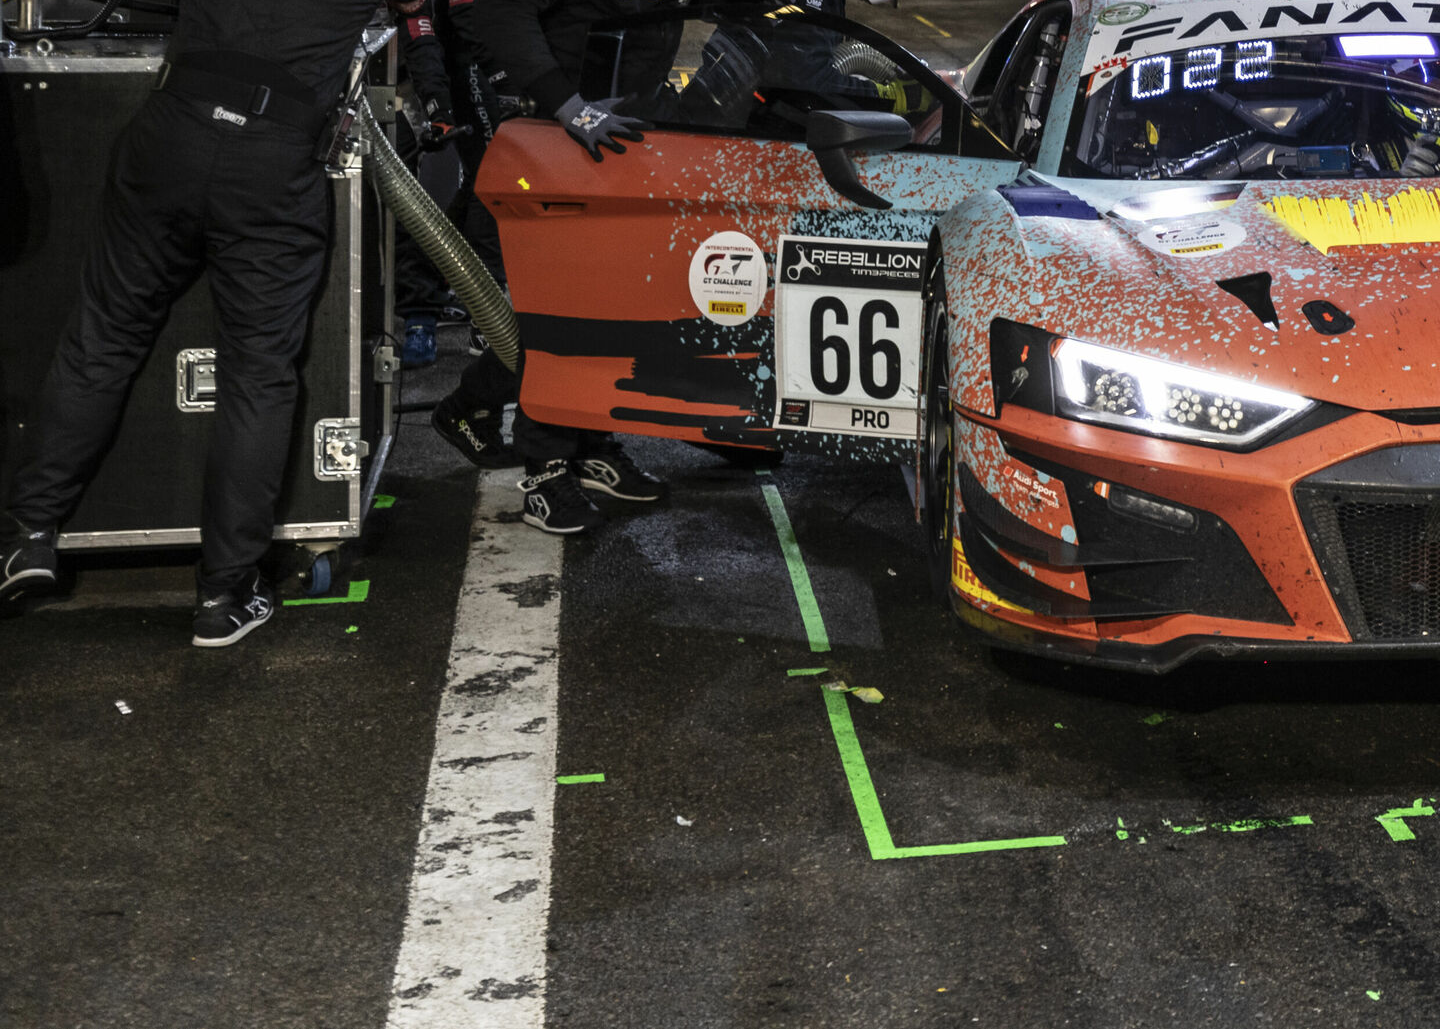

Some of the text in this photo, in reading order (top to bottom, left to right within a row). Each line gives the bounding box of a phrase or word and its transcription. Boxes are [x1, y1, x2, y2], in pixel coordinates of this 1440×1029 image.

[1131, 39, 1273, 99] 022
[704, 245, 754, 253] INTERCONTINENTAL
[811, 249, 921, 270] REBELLION
[713, 278, 753, 287] CHALLENGE
[711, 303, 744, 314] PIRELLI
[809, 295, 902, 400] 66
[851, 408, 890, 429] PRO
[458, 419, 488, 452] speed
[1013, 468, 1057, 500] Audi Sport
